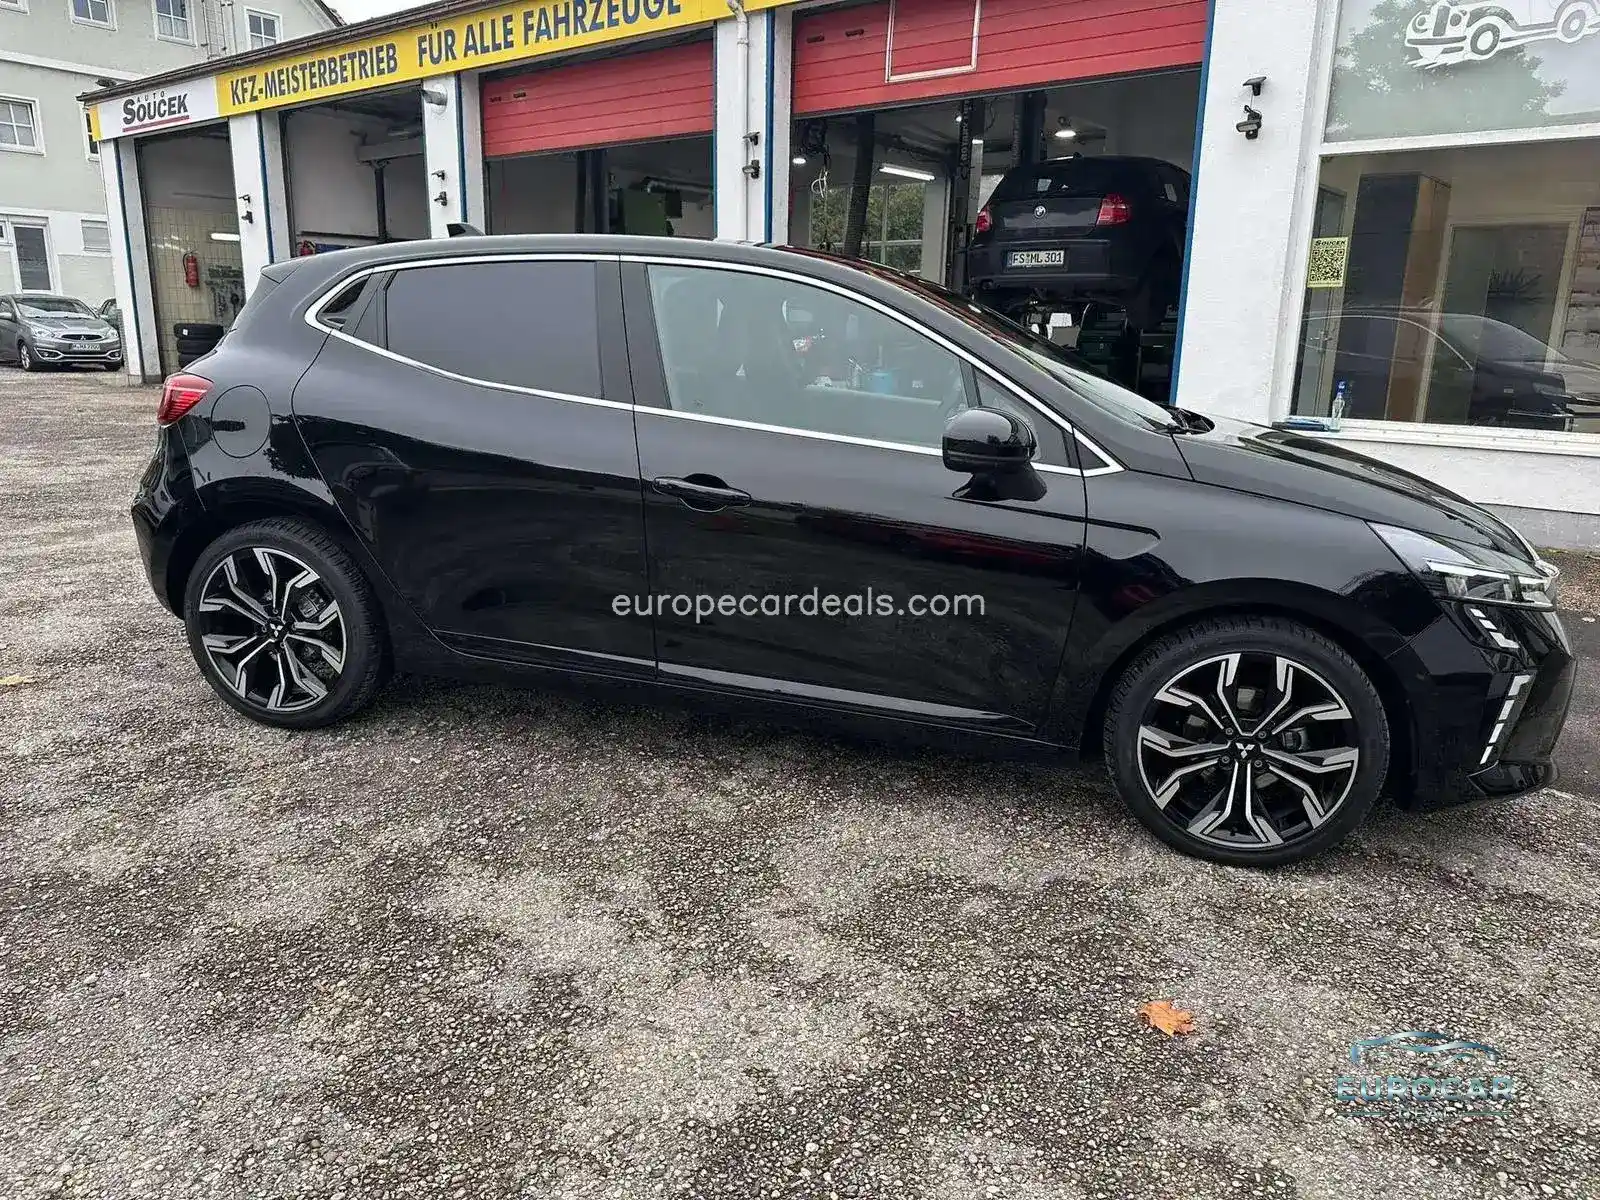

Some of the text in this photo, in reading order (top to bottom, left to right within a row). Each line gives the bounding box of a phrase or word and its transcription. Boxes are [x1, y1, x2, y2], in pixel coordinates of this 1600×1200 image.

[230, 42, 398, 106] KFZ-MEISTERBETRIEB
[417, 23, 457, 67] FÜR
[463, 14, 515, 58] ALLE
[136, 90, 165, 104] AUTO
[122, 93, 189, 125] SOUCEK
[1045, 252, 1063, 263] 301
